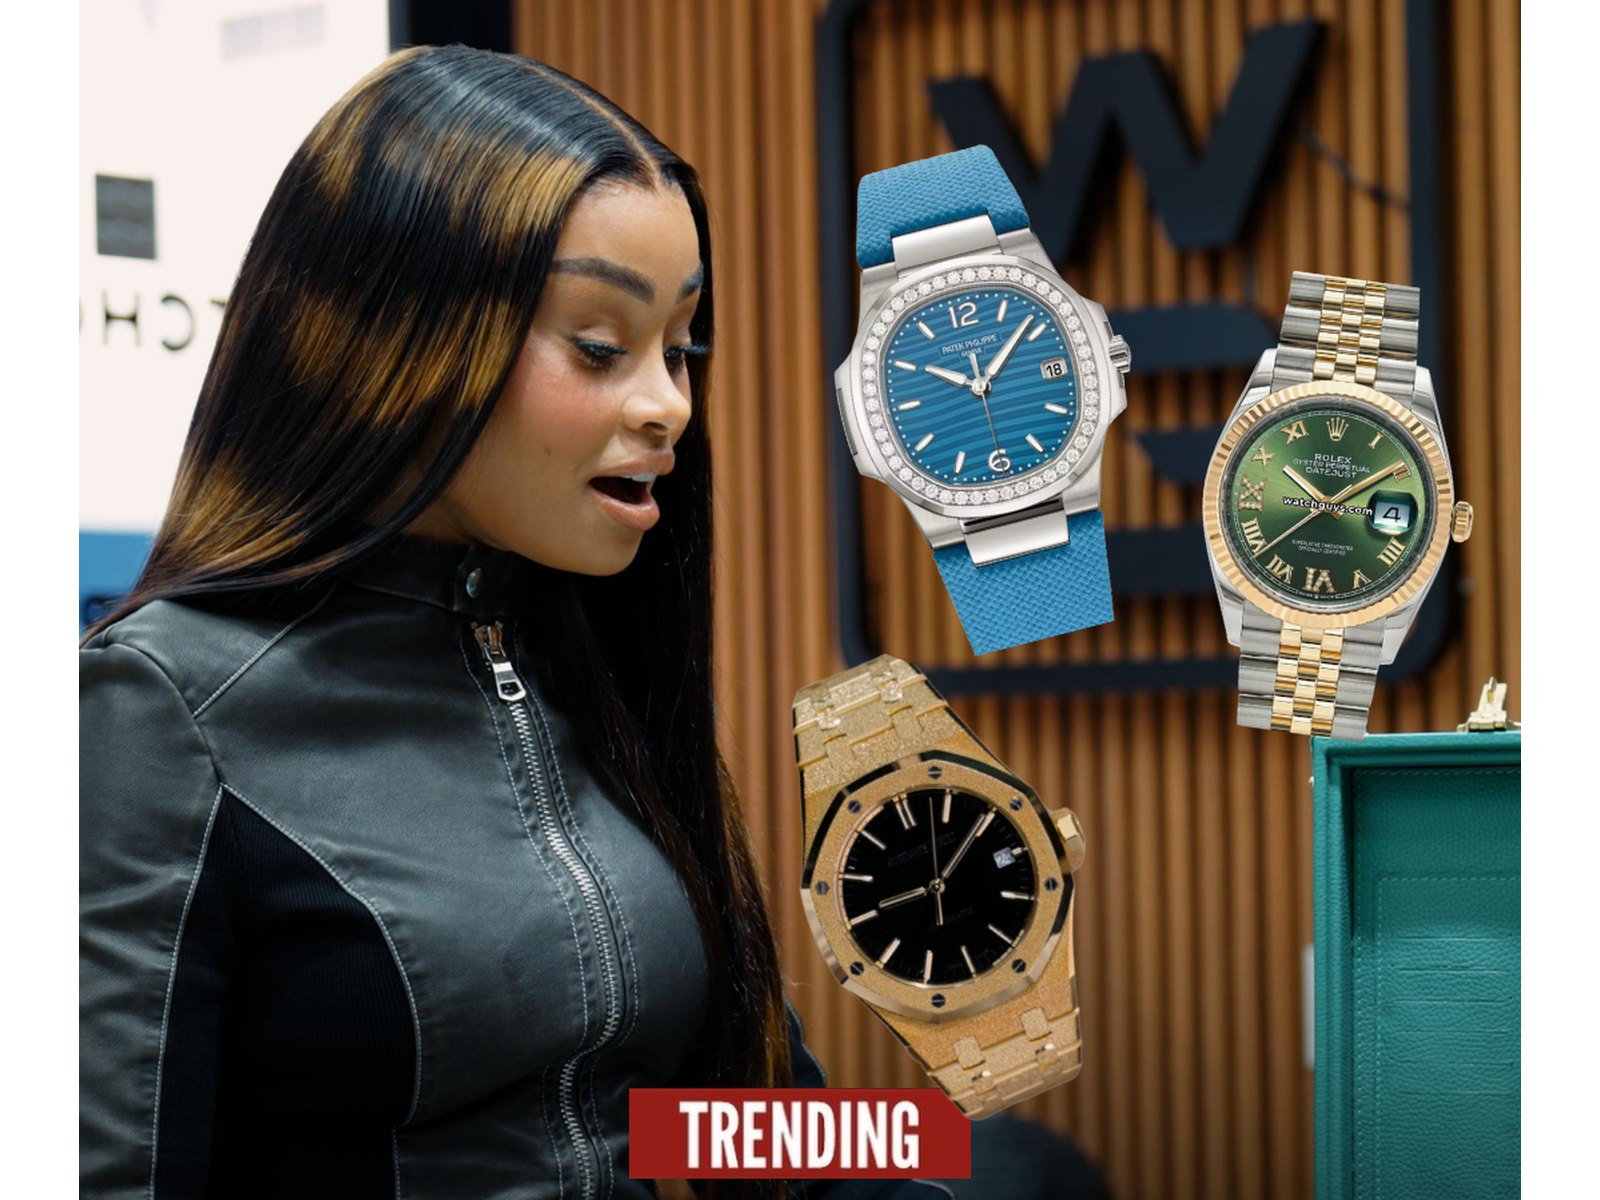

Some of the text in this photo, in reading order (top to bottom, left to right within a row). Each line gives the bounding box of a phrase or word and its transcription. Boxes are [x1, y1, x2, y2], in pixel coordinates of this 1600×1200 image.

[949, 301, 979, 328] 12
[942, 334, 998, 354] PATEK PHILIPPE
[1046, 363, 1063, 377] 18
[988, 449, 1011, 472] 6
[1293, 458, 1371, 473] OYSTER PERPETUAL
[1315, 453, 1352, 464] ROLEX
[1305, 466, 1358, 478] DATEJUST
[1382, 507, 1401, 522] 4
